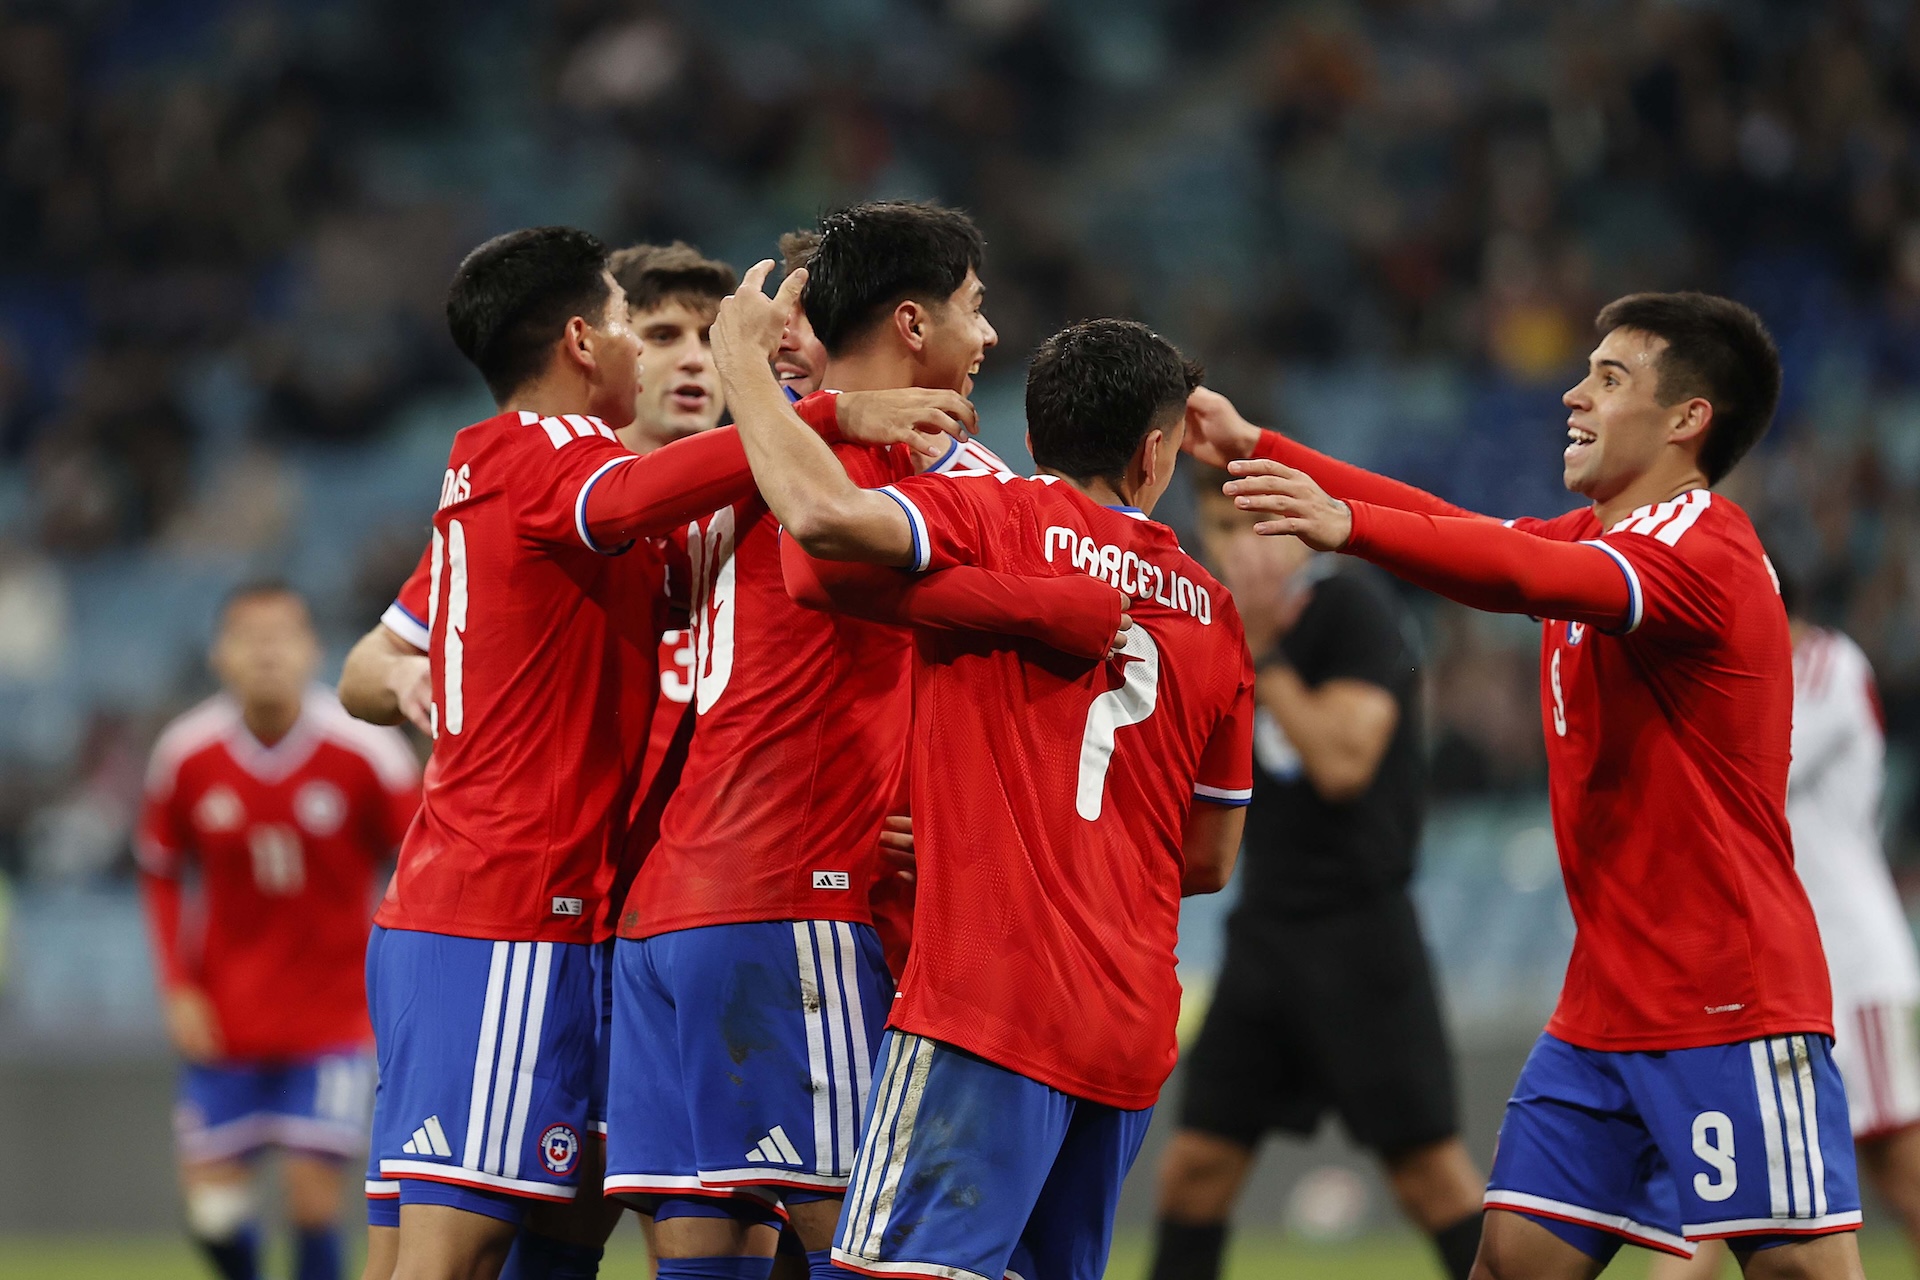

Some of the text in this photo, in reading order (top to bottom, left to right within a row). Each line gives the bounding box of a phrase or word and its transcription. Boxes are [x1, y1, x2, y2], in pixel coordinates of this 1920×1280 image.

[1044, 525, 1212, 626] MARCELINO
[1075, 621, 1159, 822] 7
[1691, 1110, 1738, 1202] 9
